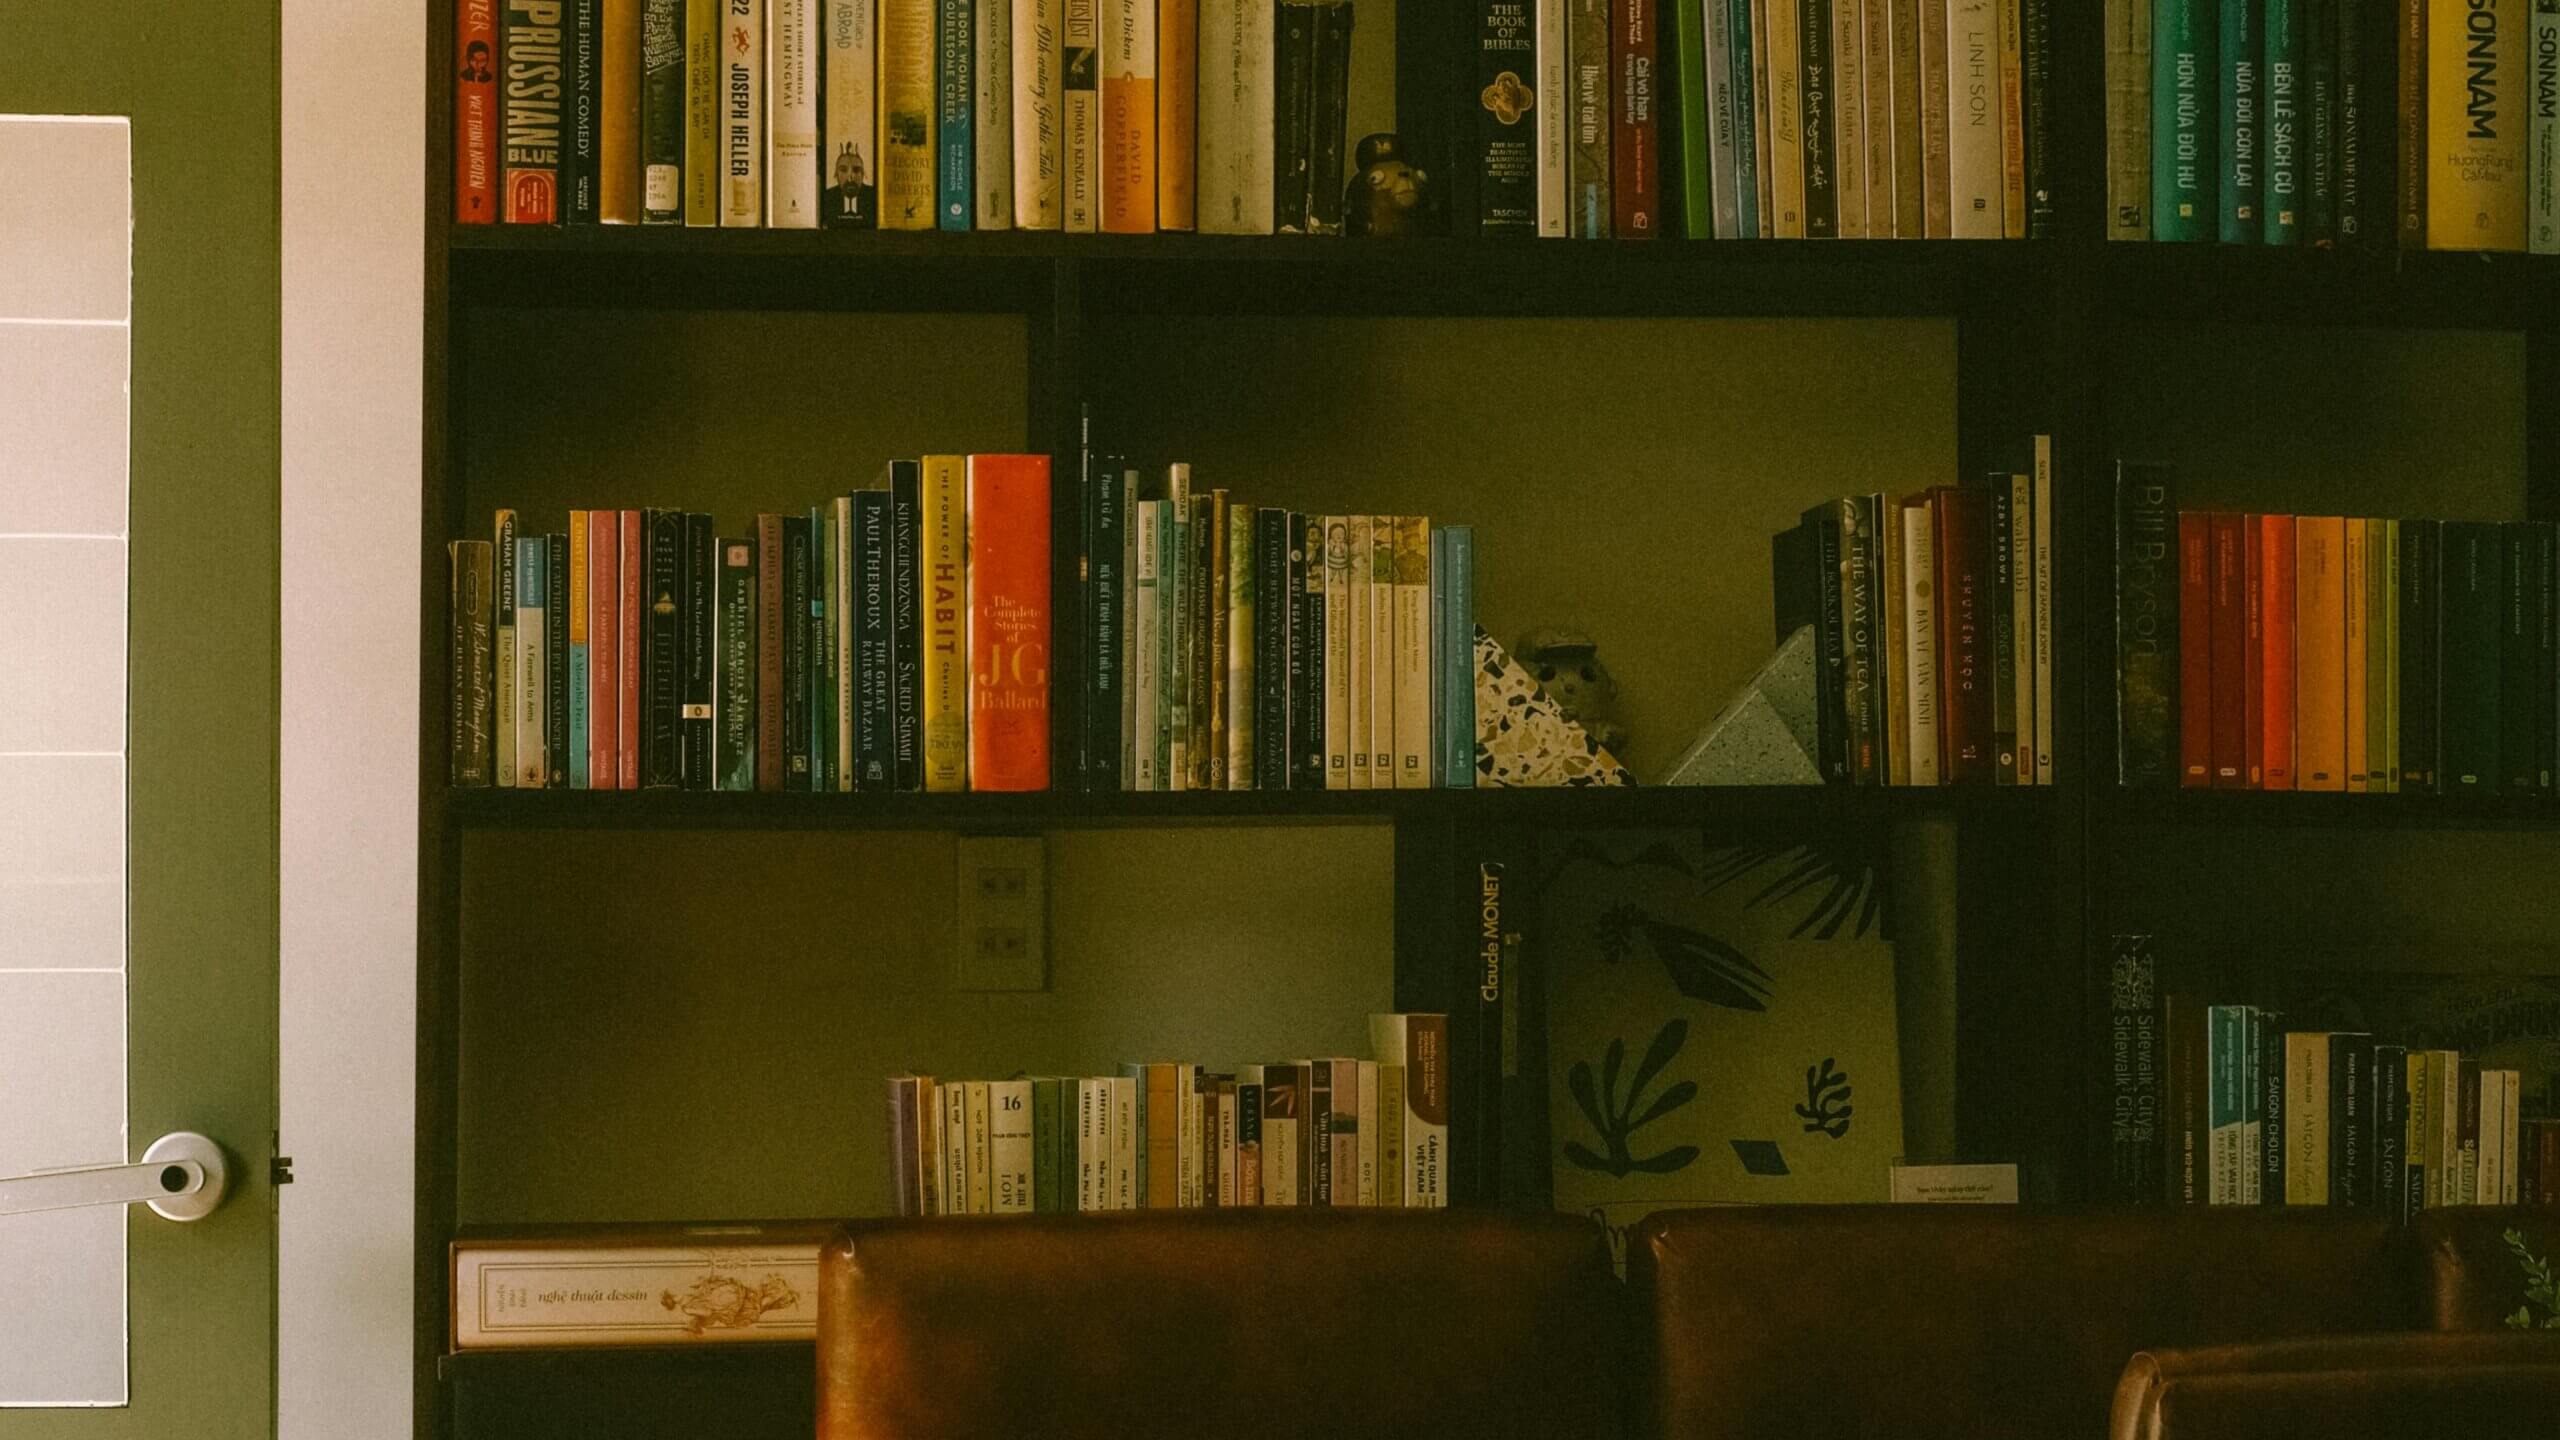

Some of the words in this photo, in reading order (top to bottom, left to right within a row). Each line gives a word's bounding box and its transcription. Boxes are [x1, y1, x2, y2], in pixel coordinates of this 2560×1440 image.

[577, 1, 590, 27] THE
[1487, 15, 1527, 27] BOOK
[1491, 4, 1522, 15] THE
[958, 12, 968, 48] BOOK
[1123, 17, 1134, 61] Dickens
[1483, 39, 1531, 51] BIBLES
[1497, 27, 1518, 38] OF
[1842, 20, 1854, 56] Suzuki
[507, 0, 561, 145] PRUSSIAN
[577, 32, 590, 90] HUMAN
[784, 24, 793, 110] HEMINGWAY
[1028, 23, 1053, 99] 19th-century
[1967, 32, 1984, 78] LINH
[2176, 53, 2198, 88] HƠN
[731, 63, 749, 120] JOSEPH
[958, 54, 968, 102] WOMAN
[2235, 61, 2257, 94] NỬA
[469, 95, 482, 116] VIET
[947, 83, 956, 123] CREEK
[2176, 93, 2201, 128] NỬA
[2235, 97, 2255, 123] ĐỜI
[577, 95, 590, 159] COMEDY
[1033, 102, 1054, 145] Gothic
[1074, 99, 1085, 145] THOMAS
[507, 148, 558, 162] BLUE
[731, 125, 749, 176] HELLER
[1115, 95, 1127, 218] COPPERFIELD
[1130, 130, 1141, 185] DAVID
[2176, 132, 2199, 160] ĐỜI
[2236, 127, 2256, 160] CÒN
[2273, 122, 2297, 167] SÁCH
[468, 150, 486, 189] NGUYEN
[1039, 147, 1054, 180] Tales
[1073, 149, 1085, 201] KENEALLY
[2176, 166, 2197, 190] HƯ
[2233, 163, 2253, 187] LẠI
[2273, 170, 2296, 195] CŨ
[942, 468, 950, 489] THE
[1178, 478, 1187, 517] SENDAK
[1998, 495, 2006, 529] AZBY
[2135, 485, 2165, 532] Bill
[867, 506, 881, 543] PAUL
[942, 495, 950, 538] POWER
[503, 520, 513, 567] GRAHAM
[553, 543, 563, 564] THE
[575, 522, 584, 563] ERNEST
[942, 544, 950, 561] OF
[1178, 531, 1186, 565] WHERE
[2015, 517, 2027, 554] wabi
[897, 502, 911, 631] KHANGCHENDZONGA
[1270, 539, 1279, 576] LIGHT
[1850, 544, 1864, 580] THE
[1999, 536, 2007, 585] BROWN
[2039, 546, 2047, 562] THE
[2039, 564, 2047, 579] ART
[503, 570, 513, 611] GREENE
[553, 564, 563, 615] CATCHER
[867, 545, 882, 630] THEROUX
[1178, 568, 1187, 586] THE
[1198, 566, 1207, 617] PROFESSOR
[2015, 560, 2028, 594] sabi
[2039, 580, 2047, 592] OF
[575, 564, 584, 631] HEMINGWAY
[935, 563, 956, 656] HABIT
[983, 606, 1042, 622] Complete
[992, 594, 1016, 607] The
[1178, 589, 1187, 612] WILD
[1270, 579, 1279, 633] BETWEEN
[1853, 583, 1867, 624] WAY
[2039, 593, 2047, 632] JAPANESE
[2129, 542, 2166, 657] Bryson
[456, 626, 464, 639] OF
[553, 615, 563, 629] IN
[994, 620, 1038, 631] Stories
[1006, 632, 1019, 644] of
[1178, 616, 1187, 651] THINGS
[553, 631, 563, 651] THE
[575, 651, 584, 660] A
[876, 641, 886, 666] THE
[1855, 629, 1868, 655] OF
[2039, 633, 2047, 666] JOINERY
[456, 646, 464, 688] HUMAN
[472, 636, 488, 695] Somerset
[502, 654, 513, 679] Quiet
[527, 653, 536, 688] Farewell
[553, 651, 563, 672] RYE
[862, 641, 872, 696] RAILWAY
[1856, 658, 1870, 693] TEA
[527, 689, 535, 699] to
[876, 670, 886, 713] GREAT
[899, 661, 914, 712] SACRED
[942, 662, 951, 700] Charles
[1197, 660, 1207, 705] DRAGONS
[503, 682, 512, 724] American
[527, 701, 536, 722] Arms
[980, 690, 1046, 710] Ballard
[456, 694, 464, 752] BONDAGE
[464, 697, 488, 754] Maugham
[552, 697, 563, 752] SALINGER
[575, 706, 584, 731] Feast
[863, 700, 873, 751] BAZAAR
[899, 715, 915, 762] SUMMIT
[1482, 872, 1500, 939] MONET
[1480, 942, 1499, 1002] Claude
[2114, 1015, 2131, 1086] Sidewalk
[2137, 1015, 2154, 1086] Sidewalk
[1002, 1095, 1022, 1111] 16
[2112, 1095, 2132, 1127] City
[2133, 1095, 2155, 1127] City
[1415, 1144, 1425, 1168] VIỆT
[1428, 1134, 1438, 1162] CẢNH
[1416, 1169, 1425, 1194] NAM
[1427, 1164, 1437, 1193] QUAN
[538, 1290, 567, 1305] nghệ
[570, 1289, 604, 1304] thuật
[607, 1289, 648, 1302] dessin
